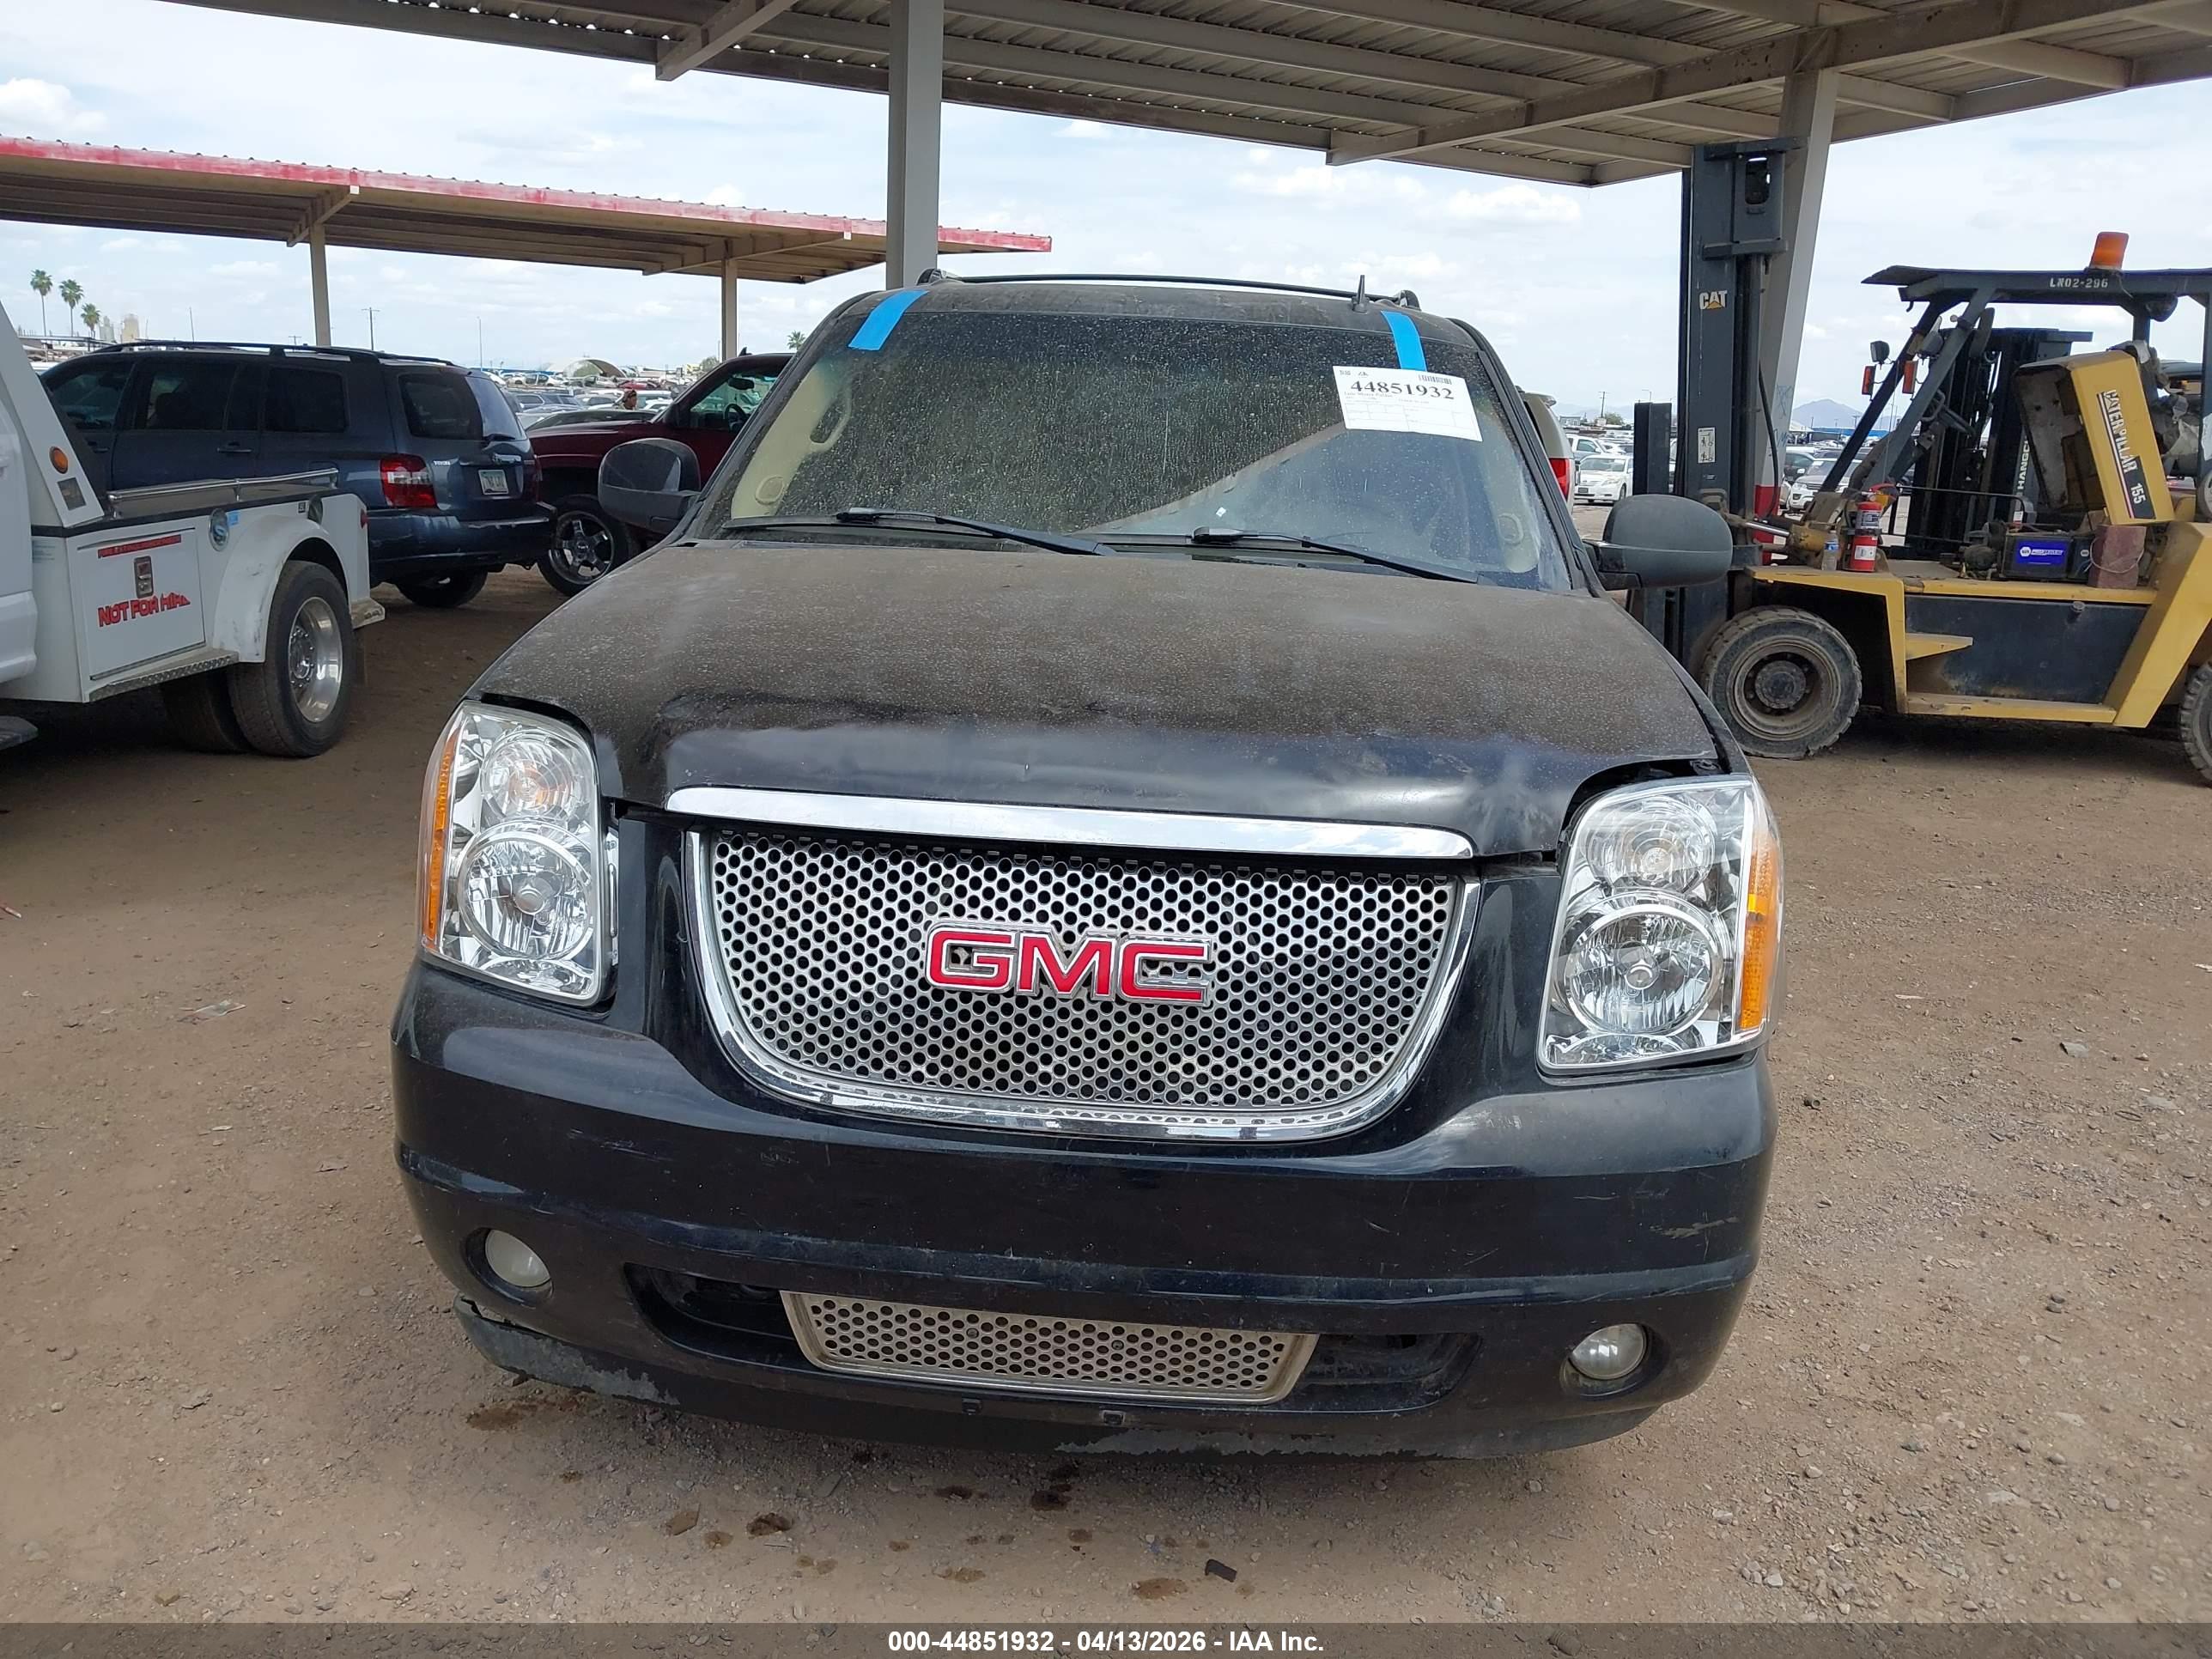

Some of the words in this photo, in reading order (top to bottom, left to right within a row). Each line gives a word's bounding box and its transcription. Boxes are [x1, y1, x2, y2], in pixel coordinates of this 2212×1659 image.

[1698, 289, 1728, 310] CAT
[1351, 380, 1455, 400] 44851932
[2017, 435, 2030, 489] HANGC
[2103, 389, 2138, 473] CATERPILLAR
[2130, 483, 2147, 504] 155
[97, 600, 130, 628] NOT
[925, 921, 1212, 1006] GMC
